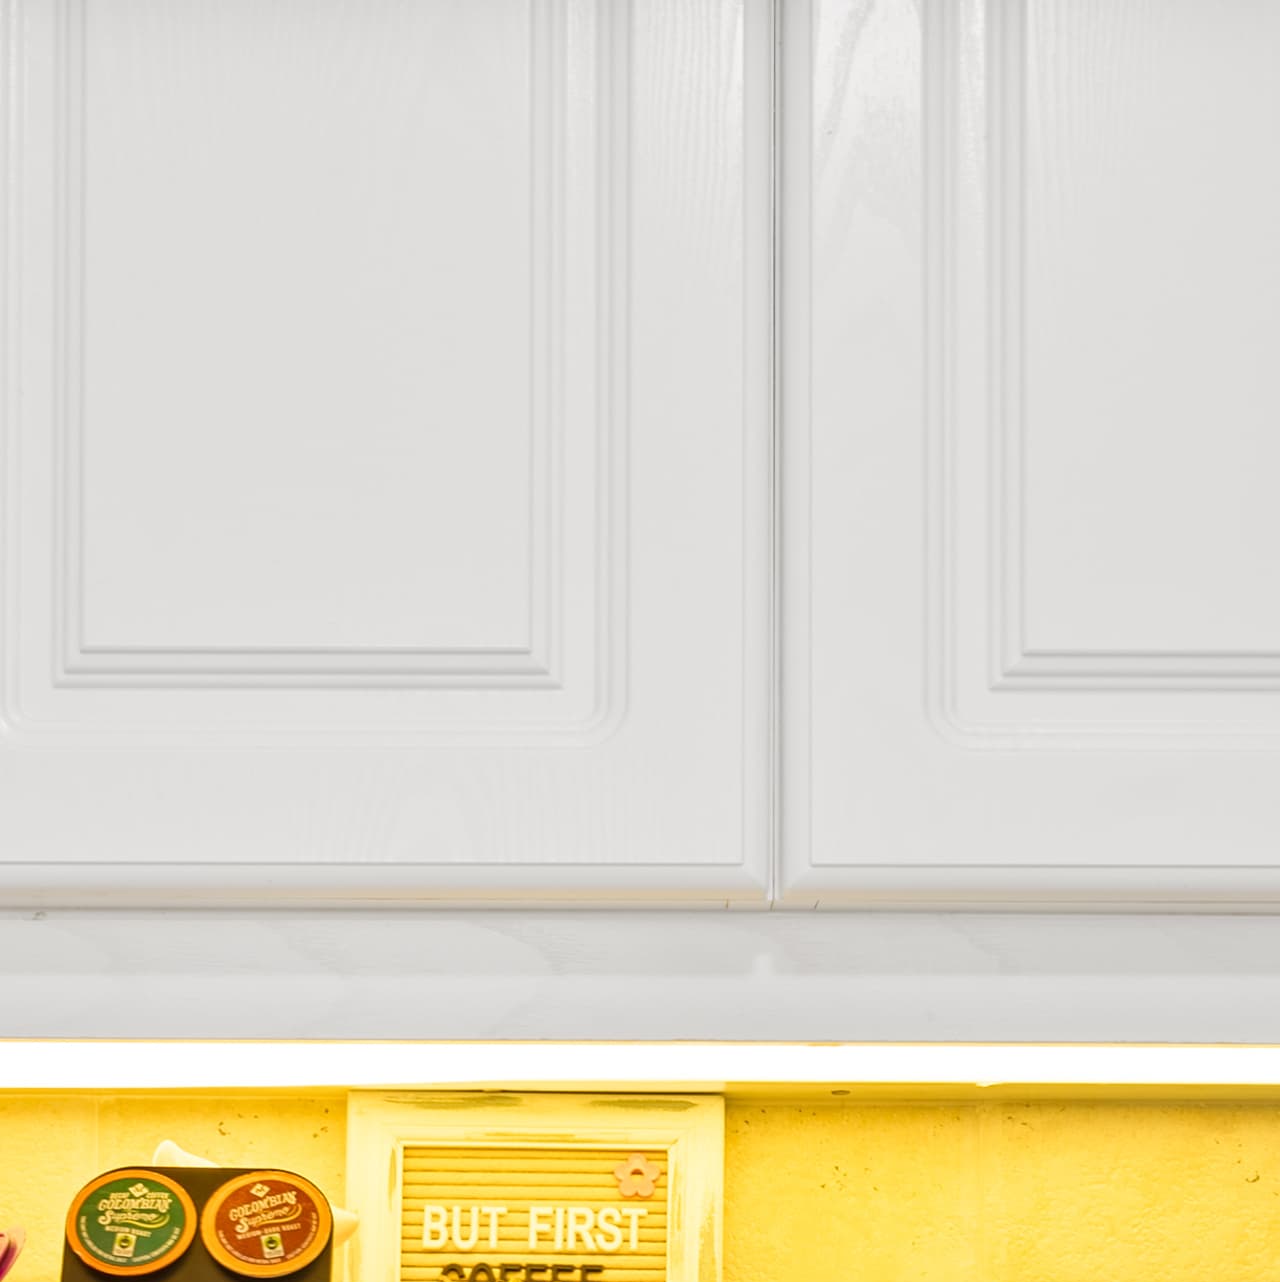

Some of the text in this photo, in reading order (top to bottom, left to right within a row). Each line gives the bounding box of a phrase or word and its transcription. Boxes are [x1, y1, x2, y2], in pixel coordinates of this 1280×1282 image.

[228, 1190, 297, 1222] COLOMBIAN
[422, 1204, 648, 1251] BUT FIRST
